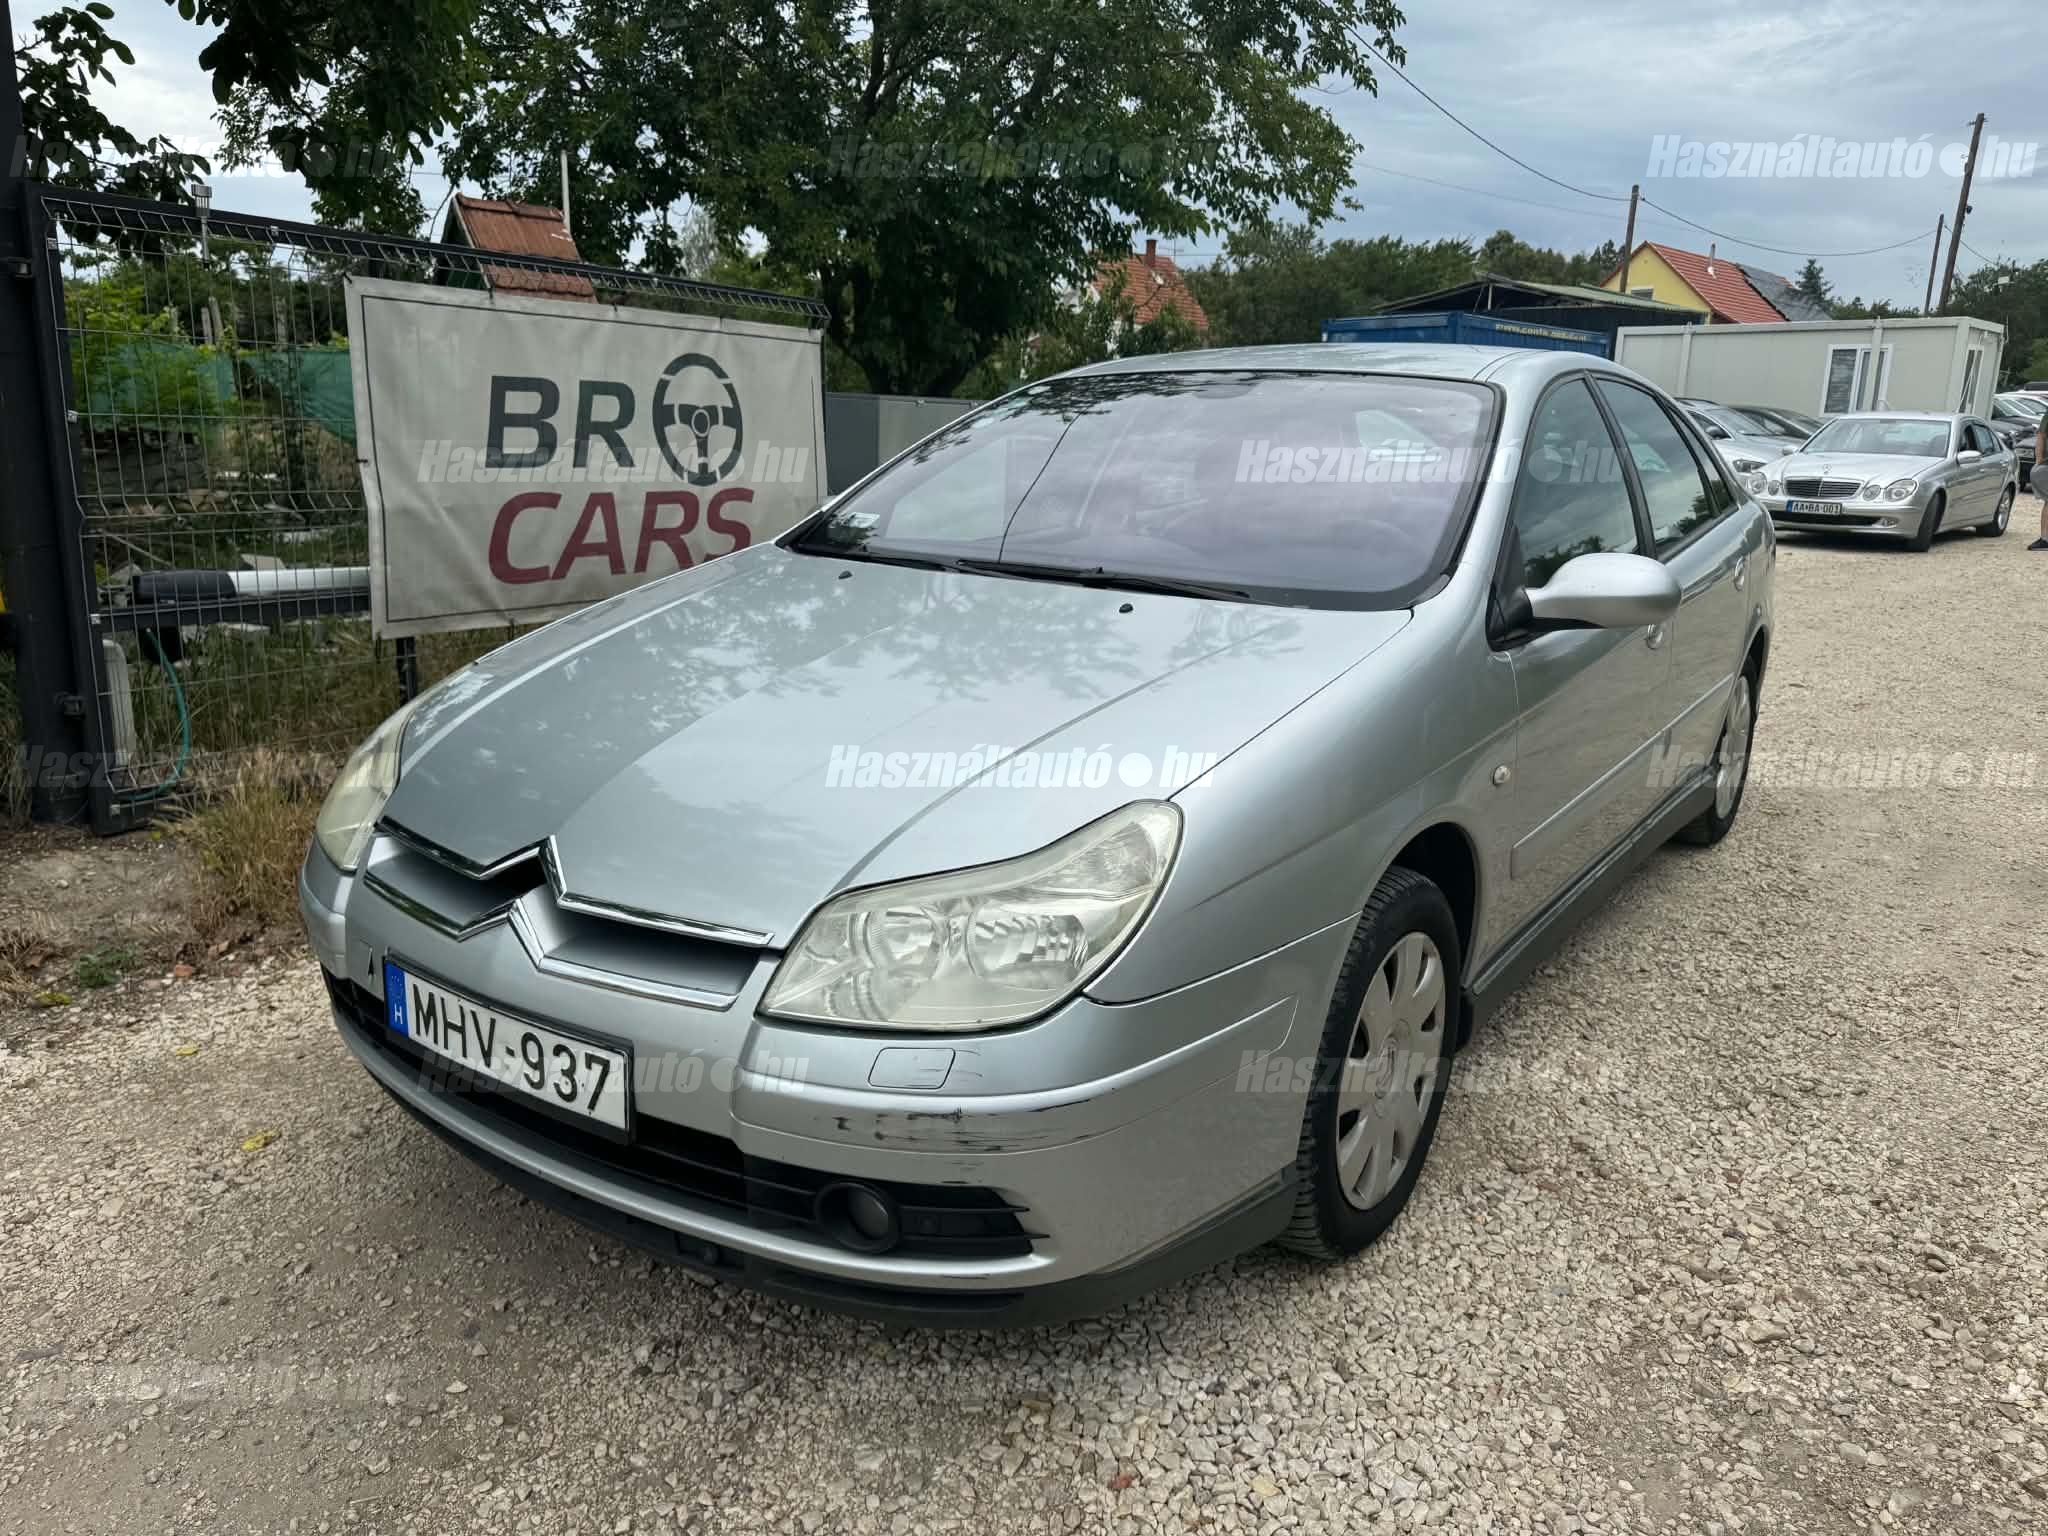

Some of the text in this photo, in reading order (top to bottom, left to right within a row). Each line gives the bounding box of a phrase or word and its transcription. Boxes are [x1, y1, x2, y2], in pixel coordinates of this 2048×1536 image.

[488, 487, 755, 585] CARS
[393, 1003, 404, 1026] H
[413, 984, 610, 1111] MHV-937
